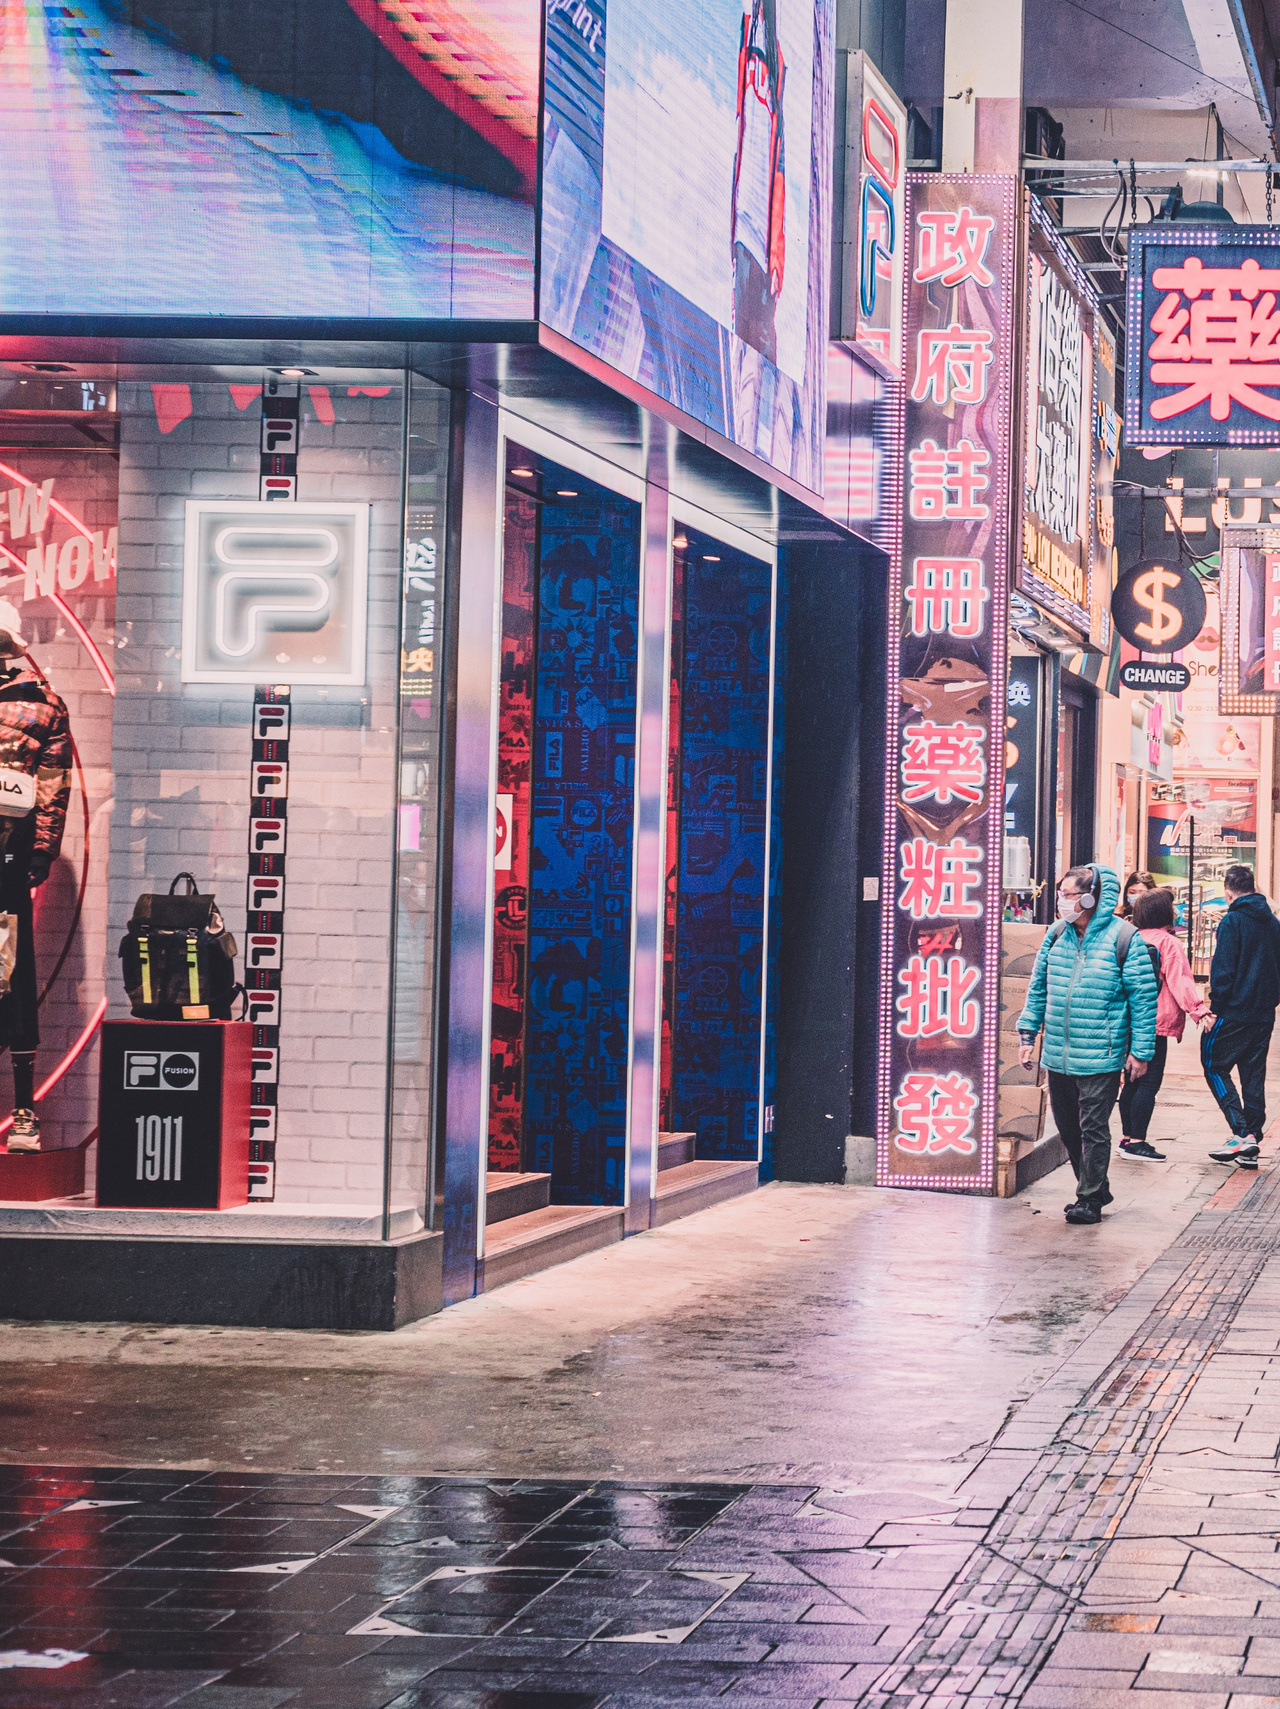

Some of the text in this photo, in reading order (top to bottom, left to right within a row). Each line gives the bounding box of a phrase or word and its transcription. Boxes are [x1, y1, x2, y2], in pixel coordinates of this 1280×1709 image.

[905, 205, 996, 640] 政府註冊
[1124, 667, 1186, 685] CHANGE
[164, 1066, 195, 1075] FUSION
[135, 1114, 183, 1182] 1911
